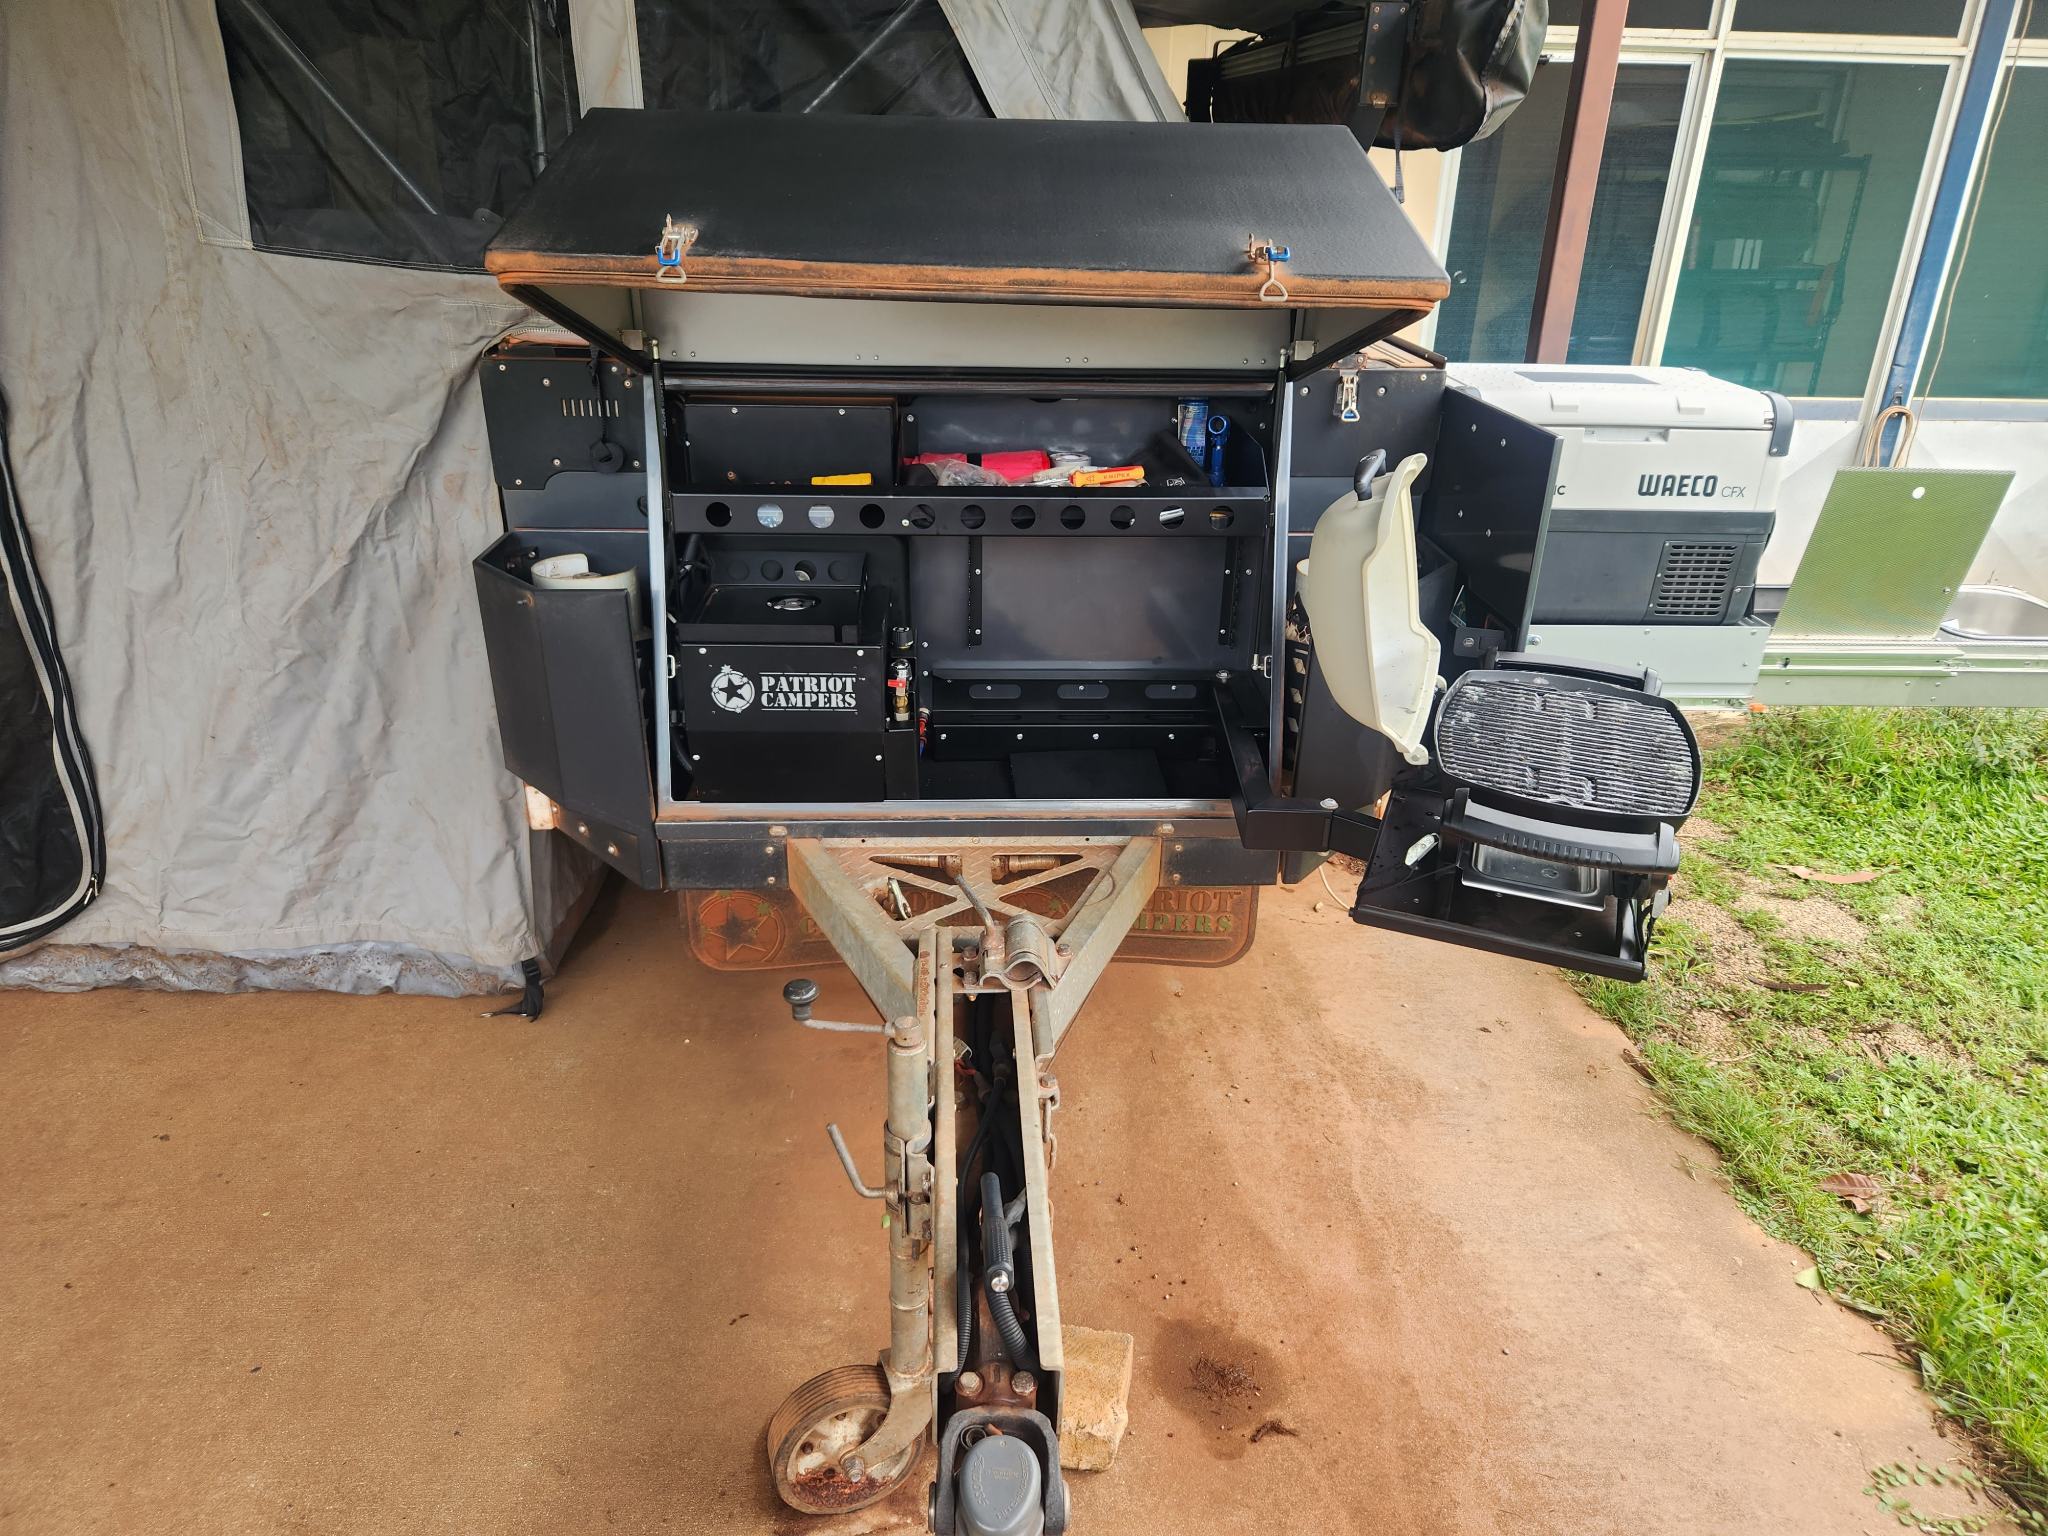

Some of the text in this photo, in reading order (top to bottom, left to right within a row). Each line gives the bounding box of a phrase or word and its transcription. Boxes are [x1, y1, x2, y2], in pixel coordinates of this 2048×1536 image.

[1638, 474, 1718, 497] WAECO
[1721, 486, 1746, 497] CFX
[760, 676, 857, 693] PATRIOT
[760, 692, 857, 708] CAMPERS
[1151, 889, 1235, 913] RIOT
